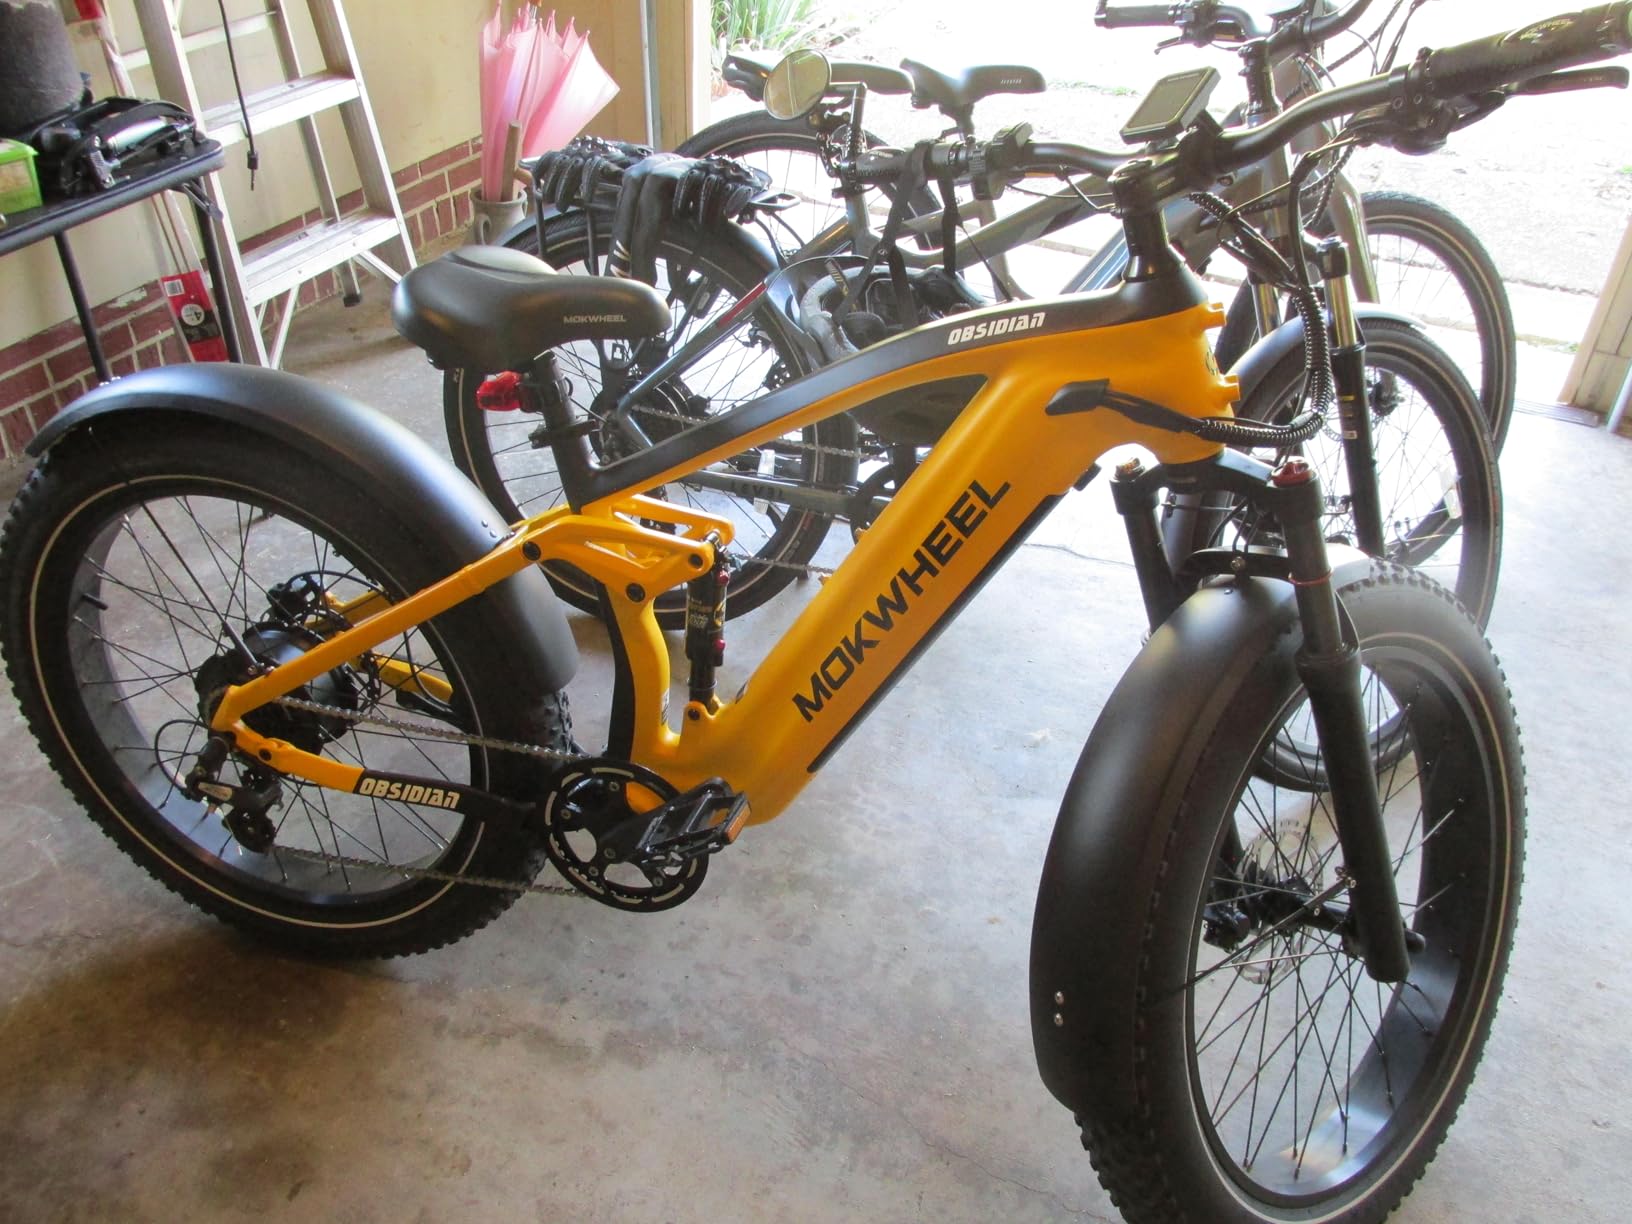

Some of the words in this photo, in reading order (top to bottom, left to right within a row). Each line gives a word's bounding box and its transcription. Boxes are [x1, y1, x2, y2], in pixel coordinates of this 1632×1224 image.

[563, 314, 626, 324] MOKWHEEL
[947, 311, 1046, 345] OBSIDIAN
[792, 480, 1011, 722] MOKWHEEL
[359, 777, 460, 809] OBSIDIAN
